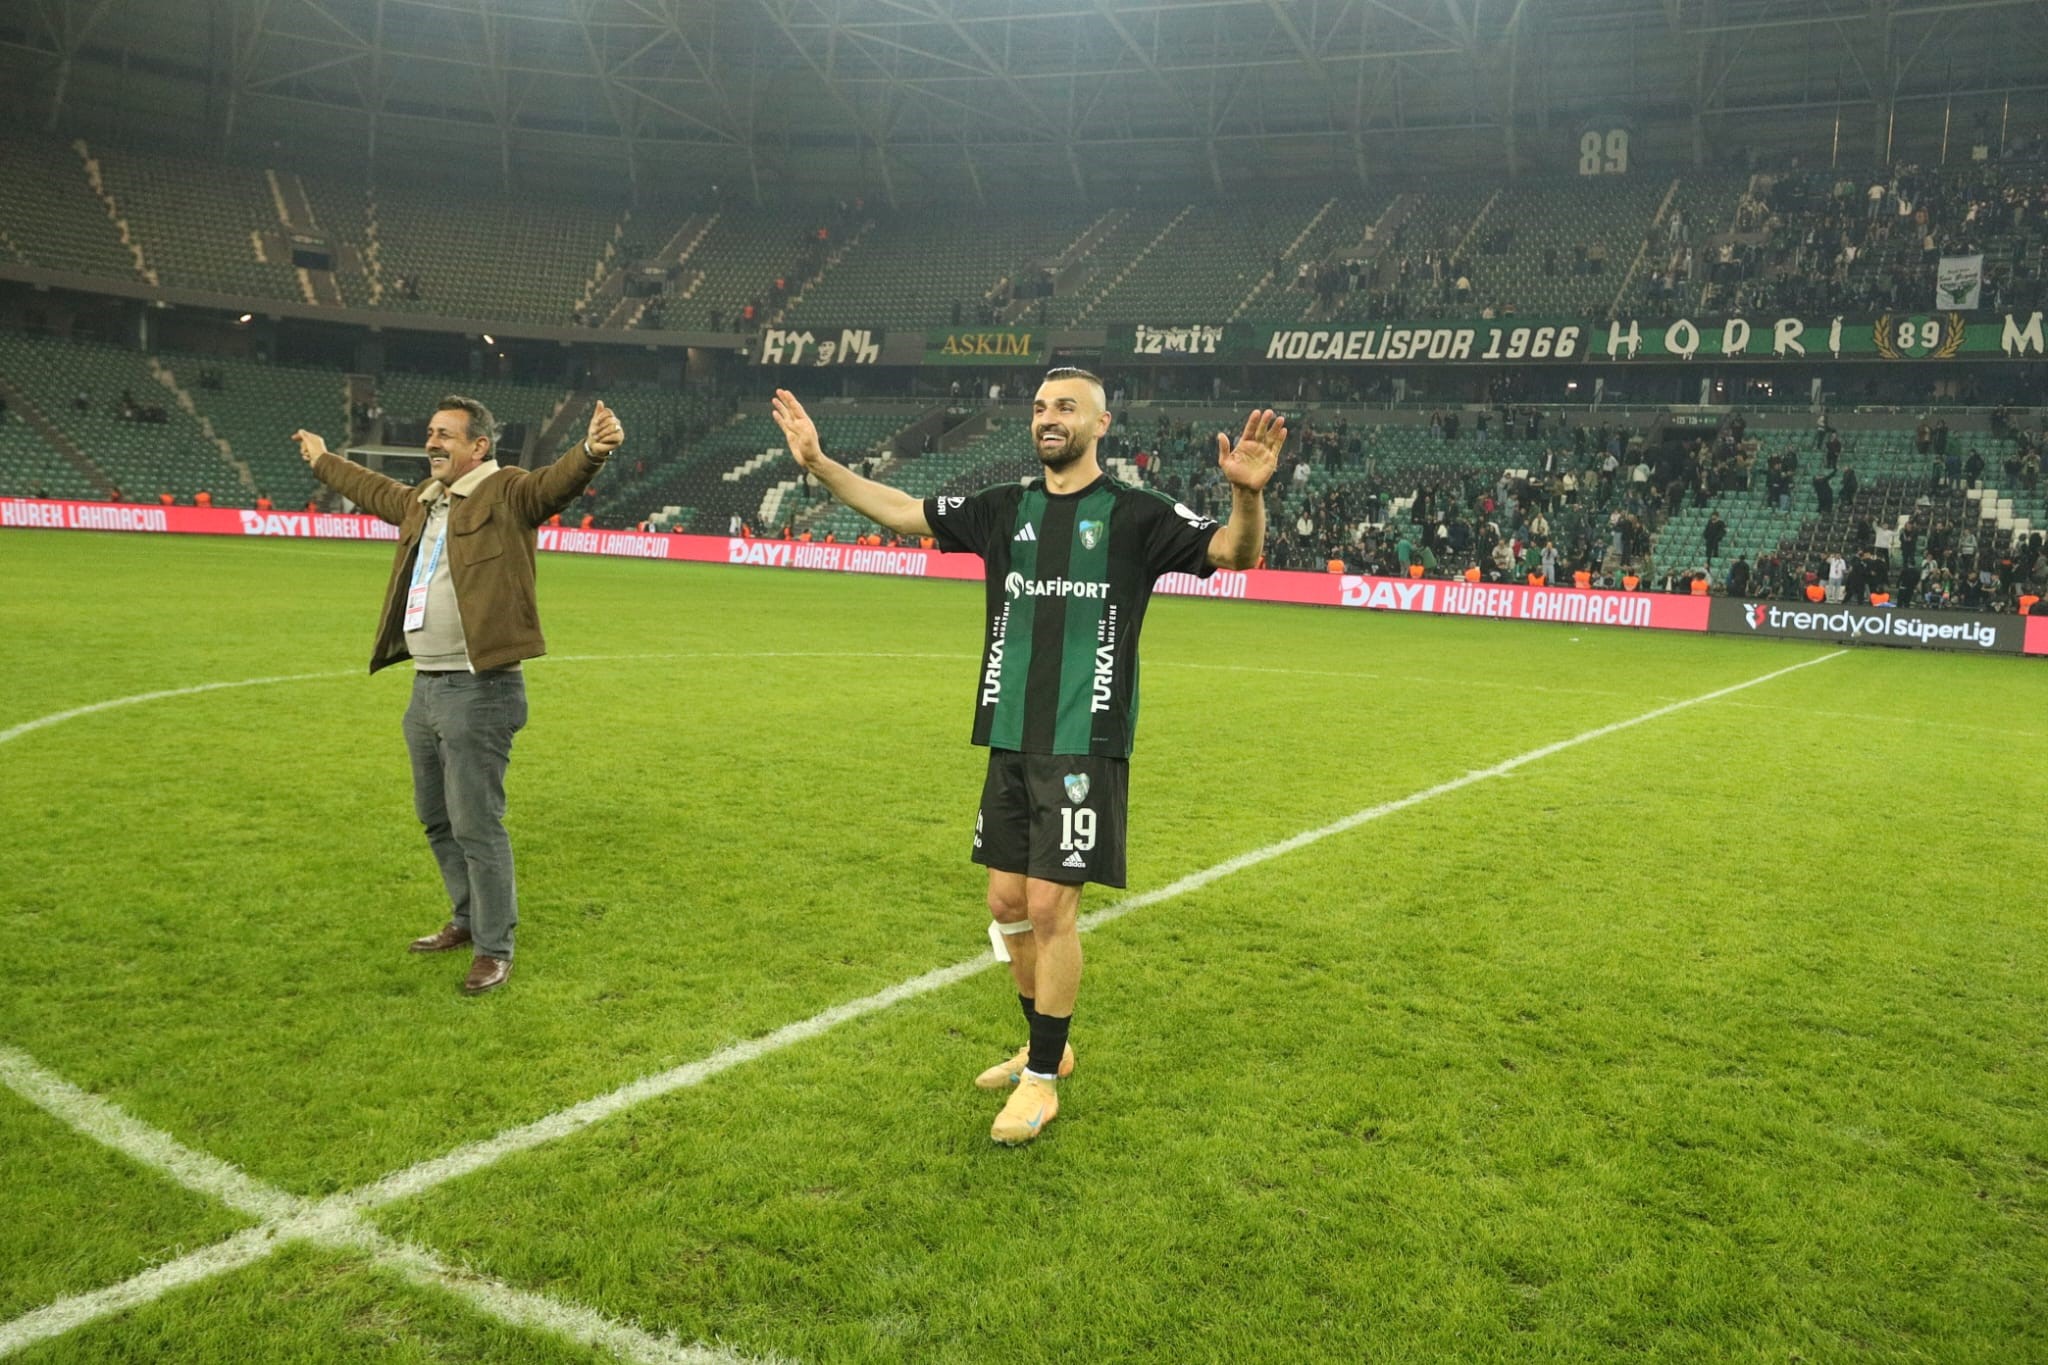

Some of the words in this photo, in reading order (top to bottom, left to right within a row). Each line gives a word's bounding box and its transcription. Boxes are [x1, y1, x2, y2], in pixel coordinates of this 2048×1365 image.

[1579, 129, 1628, 176] 89
[1266, 325, 1475, 360] KOCAELİSPOR
[1482, 326, 1580, 359] 1966
[1897, 321, 1940, 349] 89
[1, 498, 65, 527] KÜREK
[68, 505, 168, 531] LAHMACUN
[240, 509, 311, 536] DAYI
[314, 514, 361, 538] KÜREK
[561, 528, 599, 554] KÜREK
[601, 533, 670, 558] LAHMACUN
[794, 543, 840, 571] KÜREK
[843, 548, 928, 576] LAHMACUN
[1339, 575, 1436, 612] DAYI
[1442, 582, 1515, 618] KÜREK
[1520, 590, 1652, 627] LAHMACUN
[1769, 606, 1890, 636] trendyol
[1060, 808, 1097, 850] 19
[1062, 860, 1086, 868] adidas
